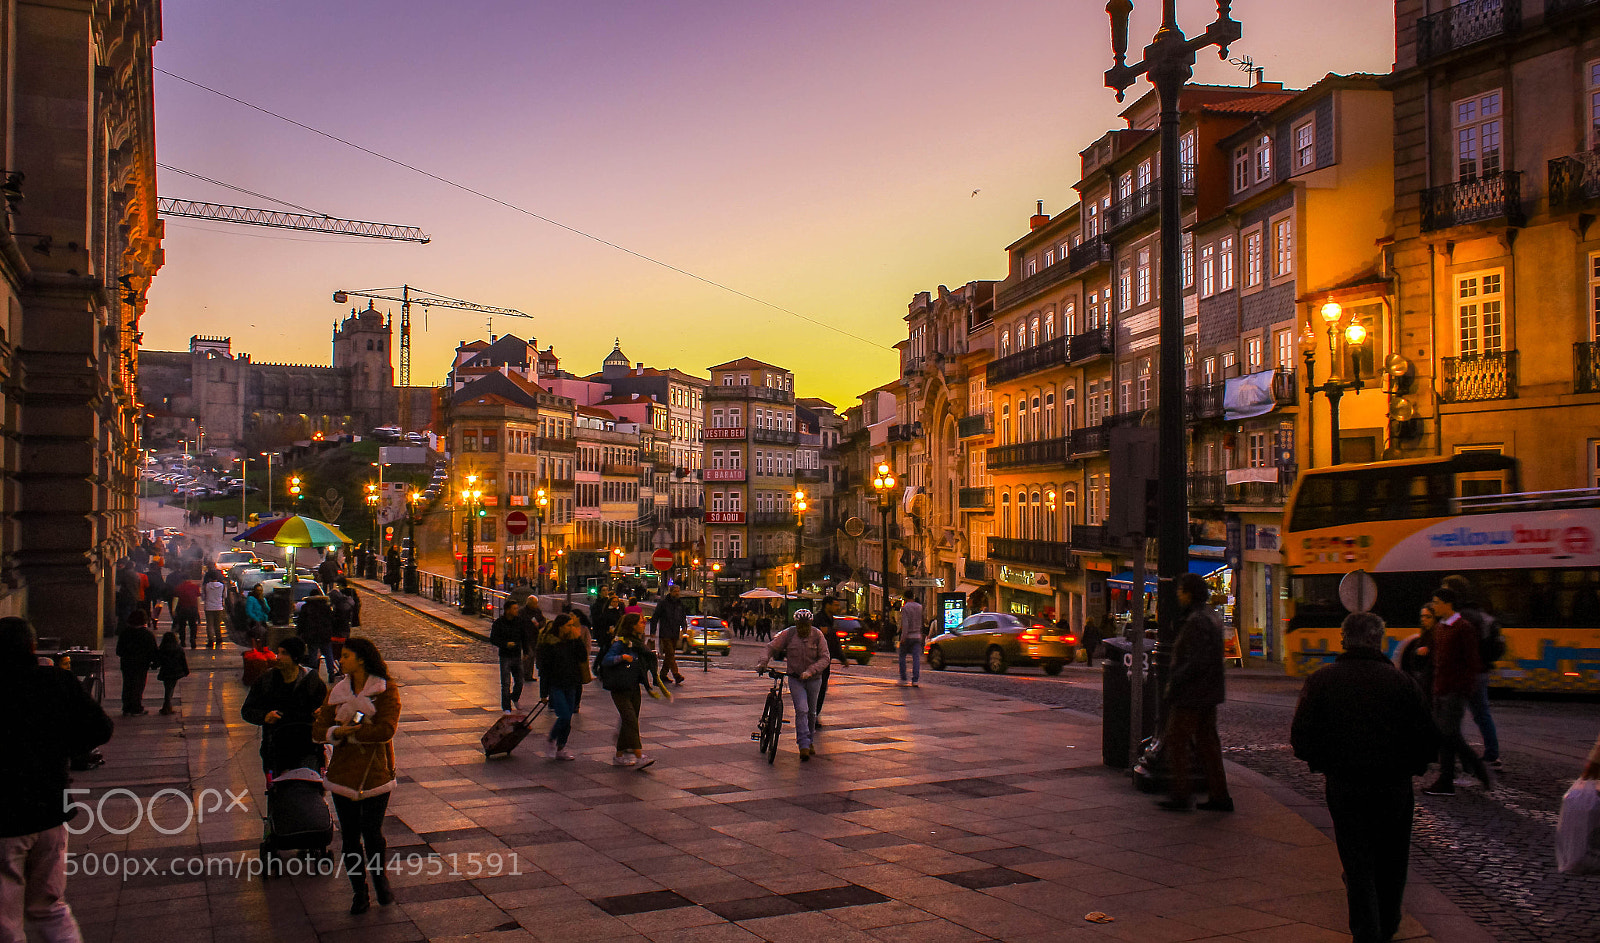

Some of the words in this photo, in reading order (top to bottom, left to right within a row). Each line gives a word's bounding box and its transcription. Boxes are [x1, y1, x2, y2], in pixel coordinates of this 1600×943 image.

[705, 429, 729, 438] VESTIR
[730, 429, 745, 437] BEM
[714, 471, 742, 479] BARATO
[722, 513, 738, 521] AQUI
